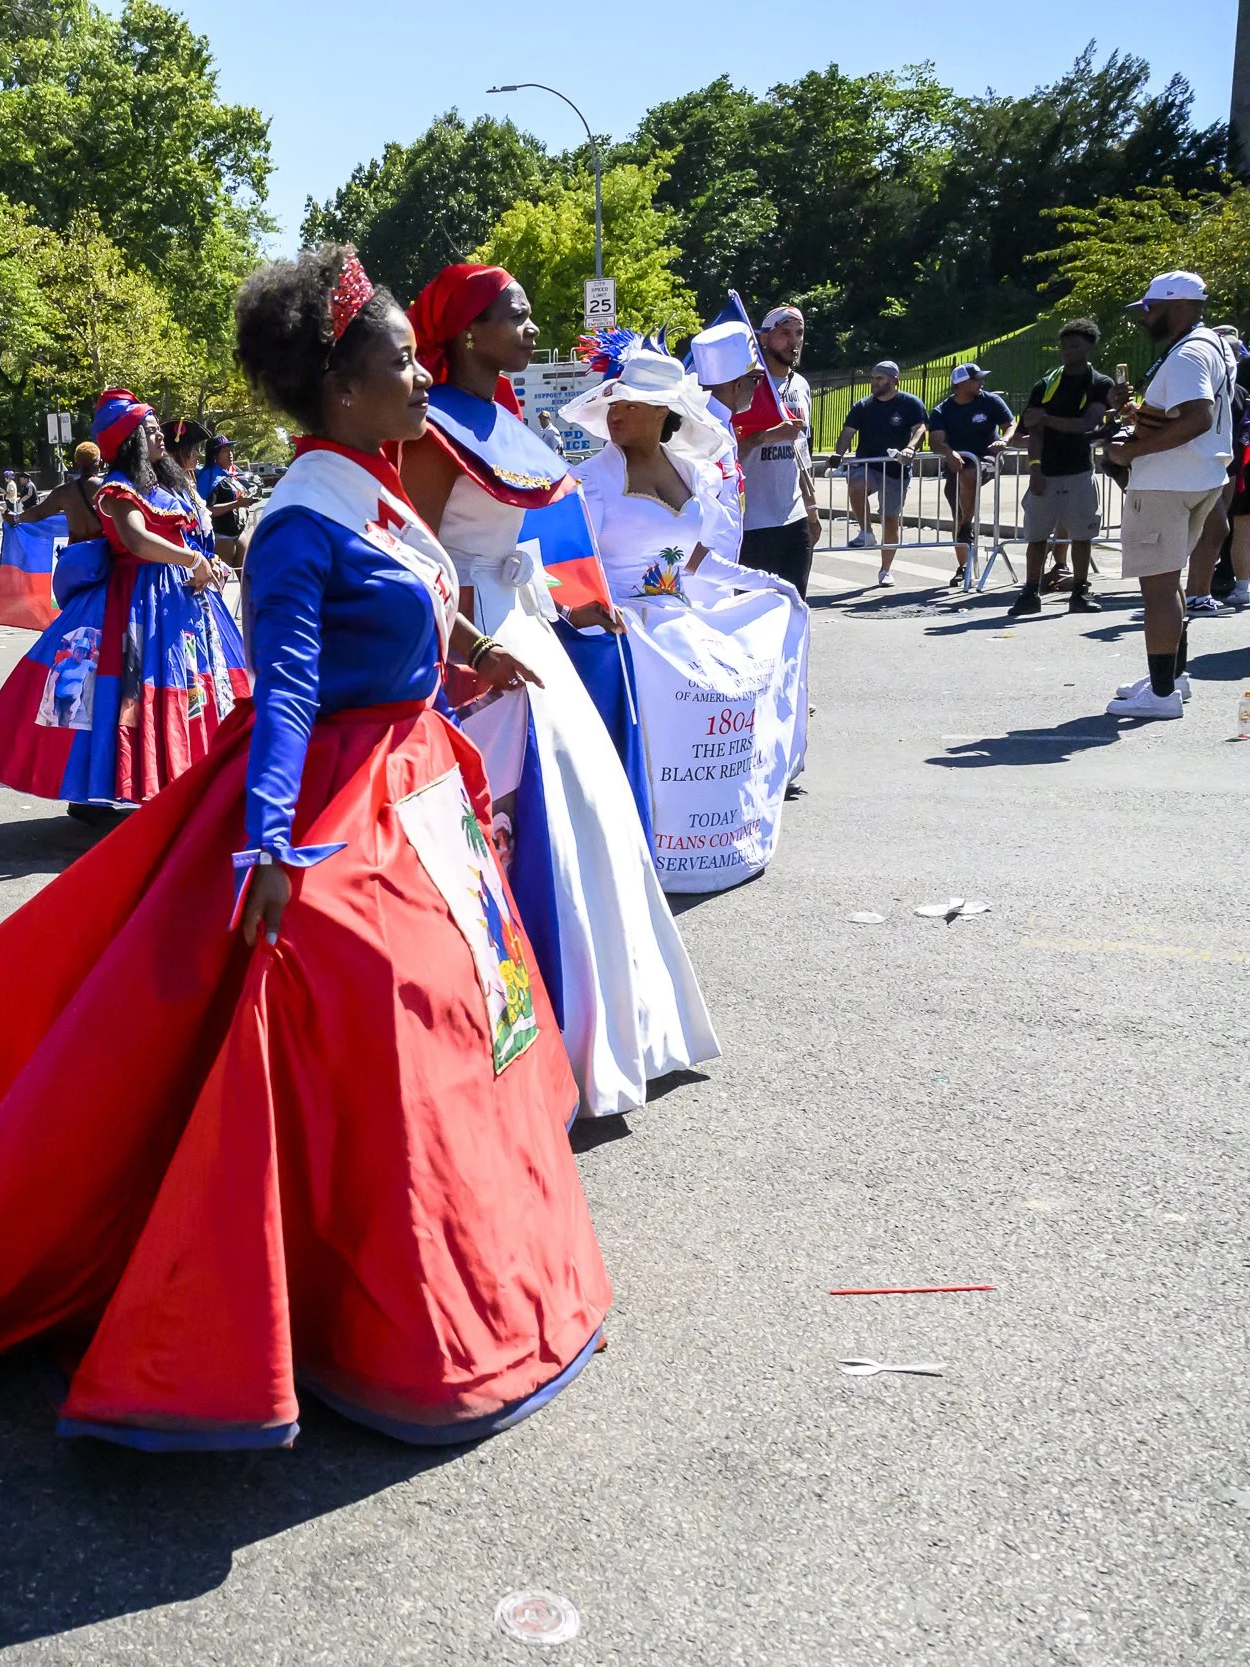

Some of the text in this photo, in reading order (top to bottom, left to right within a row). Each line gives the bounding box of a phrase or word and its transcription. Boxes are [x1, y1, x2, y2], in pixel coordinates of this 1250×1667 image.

[589, 299, 612, 313] 25
[1145, 357, 1162, 376] SONY
[760, 445, 795, 460] BECAUS
[675, 691, 691, 700] OF
[705, 708, 755, 736] 1804
[692, 735, 754, 758] THE FIRS
[660, 766, 717, 782] BLACK
[690, 809, 737, 828] TODAY
